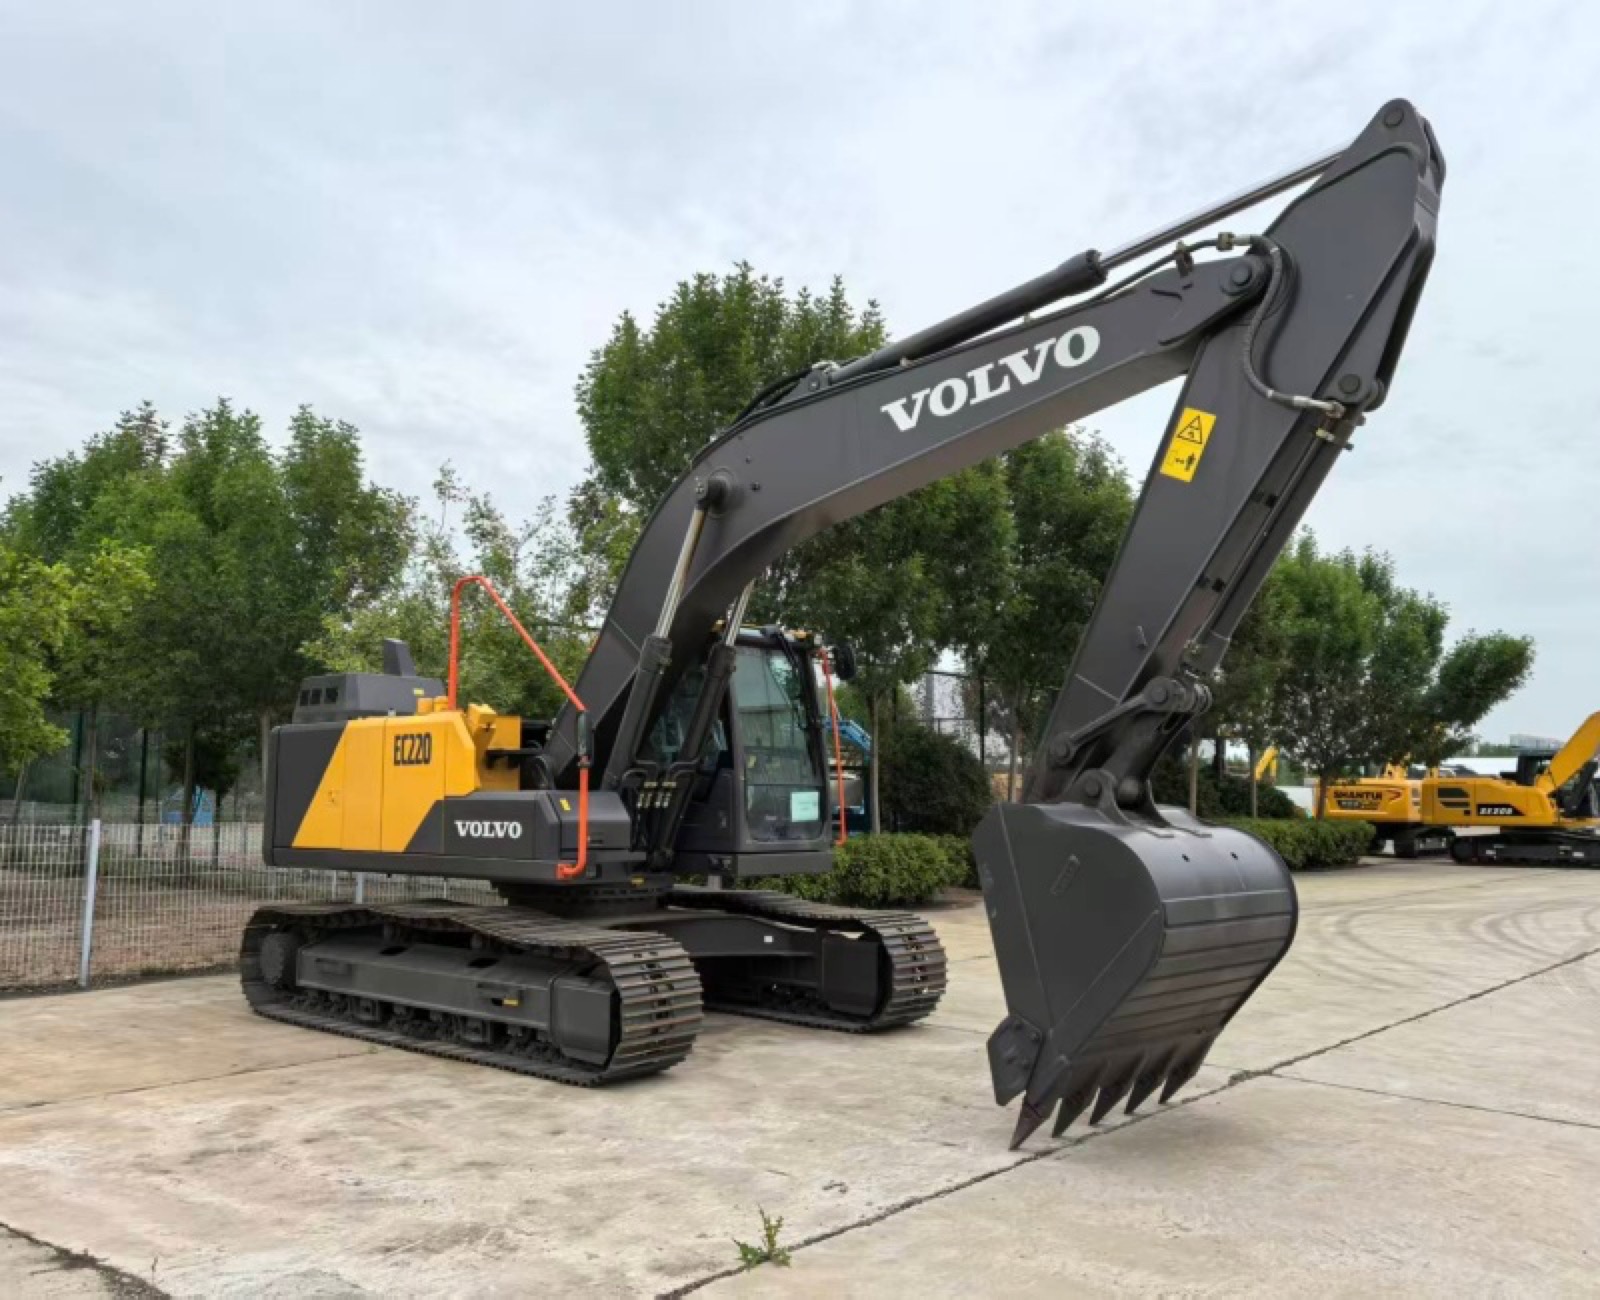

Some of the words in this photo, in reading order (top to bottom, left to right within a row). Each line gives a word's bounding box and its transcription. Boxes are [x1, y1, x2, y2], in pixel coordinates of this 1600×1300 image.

[880, 325, 1101, 432] VOLVO
[393, 732, 432, 766] EC220
[454, 820, 523, 839] VOLVO
